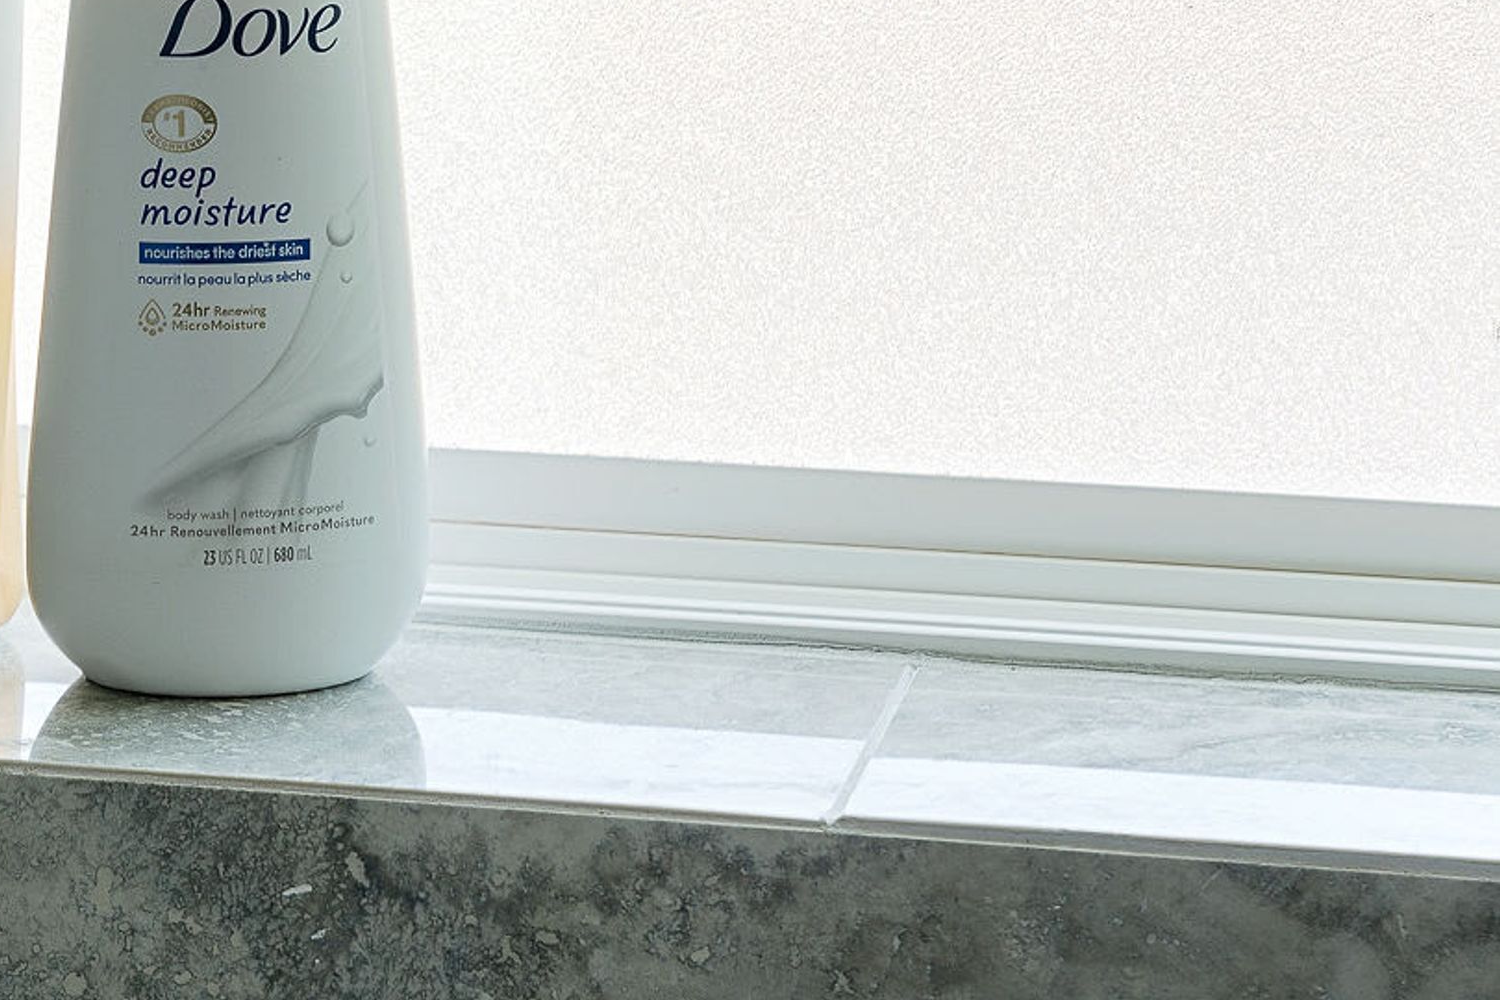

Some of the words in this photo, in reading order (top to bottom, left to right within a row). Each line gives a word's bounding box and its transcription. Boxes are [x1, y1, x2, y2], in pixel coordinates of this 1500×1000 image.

[140, 157, 216, 198] deep
[140, 197, 292, 226] moisture
[144, 246, 210, 259] nourishes
[213, 246, 234, 259] the
[238, 242, 275, 258] driest
[279, 243, 303, 256] skin
[139, 273, 181, 285] nourrit
[183, 273, 195, 285] la
[199, 275, 232, 288] peau
[234, 273, 245, 285] la
[248, 272, 273, 286] plus
[172, 302, 211, 317] 24hr
[214, 305, 267, 318] Renewing
[172, 319, 266, 332] MicroMoisture
[167, 509, 197, 523] body
[200, 509, 229, 520] wash
[240, 507, 295, 520] nettoyant
[298, 501, 344, 515] corporel
[130, 525, 165, 537] 24hr
[170, 525, 276, 538] Renouvellement
[280, 514, 375, 533] MicroMoisture
[204, 550, 216, 565] 23
[219, 549, 232, 565] US
[235, 548, 247, 564] FL
[250, 548, 263, 564] OZ
[274, 546, 294, 562] 680
